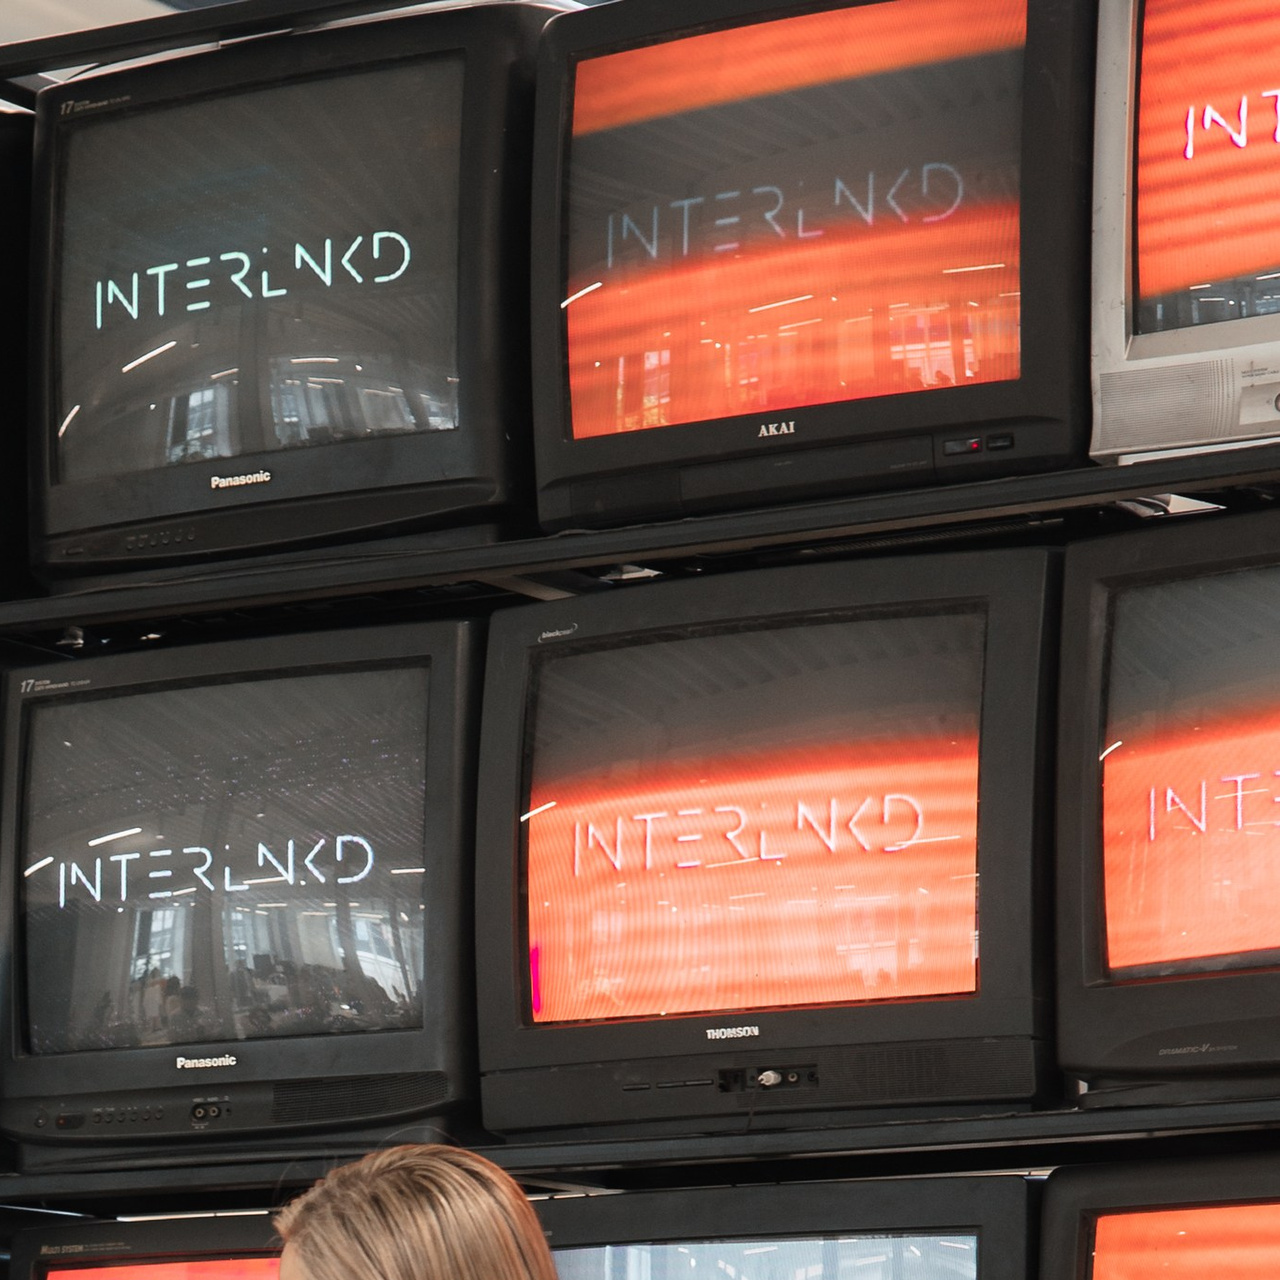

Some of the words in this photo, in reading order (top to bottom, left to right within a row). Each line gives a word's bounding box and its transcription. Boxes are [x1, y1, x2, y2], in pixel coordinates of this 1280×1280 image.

[758, 421, 796, 438] AKAI
[210, 470, 271, 489] Panasonic
[21, 679, 35, 693] 17
[1149, 771, 1280, 842] INT
[705, 1026, 760, 1040] THOMSON
[175, 1053, 237, 1070] Panasonic
